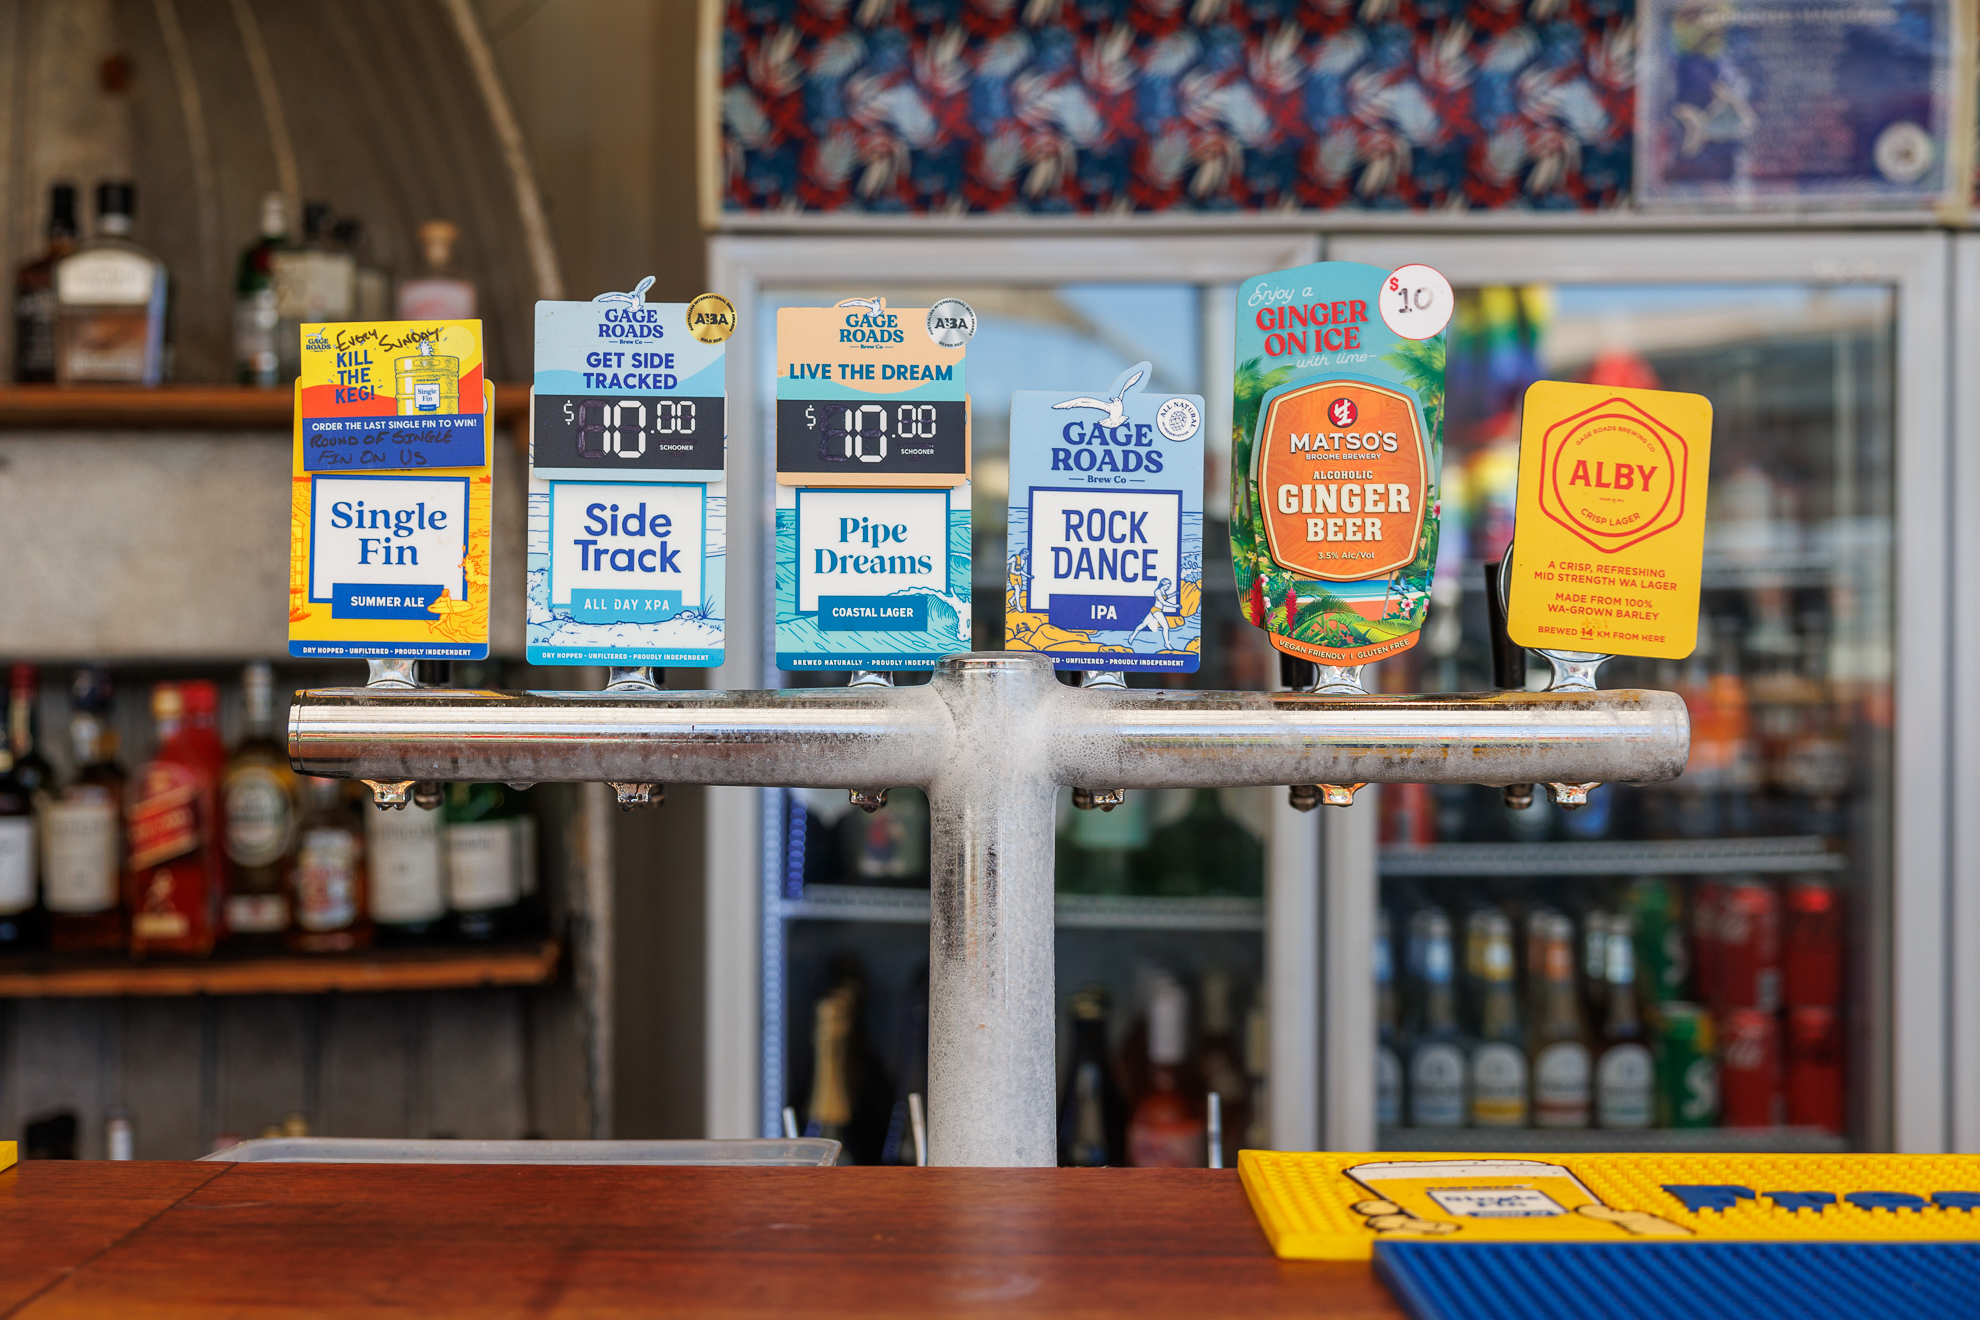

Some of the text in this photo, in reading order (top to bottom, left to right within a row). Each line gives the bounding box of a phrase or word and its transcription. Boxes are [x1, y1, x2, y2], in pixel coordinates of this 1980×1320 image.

[1248, 282, 1314, 307] Enjoy a
[605, 308, 658, 323] GAGE
[845, 313, 898, 328] GAGE
[1255, 299, 1369, 331] GINGER
[598, 324, 664, 339] ROADS
[839, 329, 904, 343] ROADS
[1264, 326, 1361, 357] ON ICE
[336, 350, 373, 368] KILL
[586, 352, 675, 369] GET SIDE
[1296, 353, 1368, 369] with lime
[337, 367, 371, 385] THE
[583, 372, 678, 390] TRACKED
[789, 363, 953, 381] LIVE THE DREAM
[335, 385, 375, 404] KEG!
[1161, 401, 1197, 428] ALL NATURAL
[312, 419, 477, 431] ORDER THE LAST SINGLE FIN TO WIN!
[1062, 421, 1153, 447] GAGE
[310, 430, 453, 448] ROUND OF SINGLE
[1576, 425, 1656, 453] GAGE ROADS BREWING CO
[317, 449, 427, 465] FIN ON US
[1051, 448, 1164, 474] ROADS
[1306, 453, 1381, 461] BROOME BREWERY
[1087, 475, 1127, 484] Brew Co
[1313, 470, 1373, 480] ALCOHOLIC
[1568, 459, 1658, 492] ALBY
[1277, 483, 1411, 514] GINGER
[331, 500, 448, 538] Single
[583, 502, 672, 538] Side
[1062, 508, 1148, 544] ROCK
[1580, 508, 1641, 527] CRISP LAGER
[838, 516, 908, 548] Pipe
[1306, 518, 1383, 542] BEER
[358, 537, 419, 566] Fin
[574, 539, 681, 573] Track
[1317, 551, 1375, 560] 3.5% Alc/Vol
[814, 549, 932, 575] Dreams
[1050, 547, 1158, 583] DANCE
[1548, 561, 1666, 578] A CRISP, REFRESHING
[1534, 571, 1677, 591] MID STRENGTH WA LAGER
[350, 596, 425, 608] SUMMER ALE
[584, 598, 670, 611] ALL DAY XPA
[1555, 592, 1653, 608] MADE FROM 100%
[832, 607, 914, 618] COASTAL LAGER
[1091, 605, 1118, 620] IPA
[1547, 604, 1659, 621] WA-GROWN BARLEY
[1538, 625, 1578, 636] BREWED
[1597, 630, 1610, 639] KM
[1612, 631, 1639, 641] FROM
[1641, 634, 1666, 643] HERE
[317, 646, 344, 654] HOPPED
[349, 647, 389, 655] UNFILTERED
[1279, 638, 1411, 660] VEGAN FRIENDLY GLUTEN FREE
[1065, 657, 1105, 665] UNFILTERED
